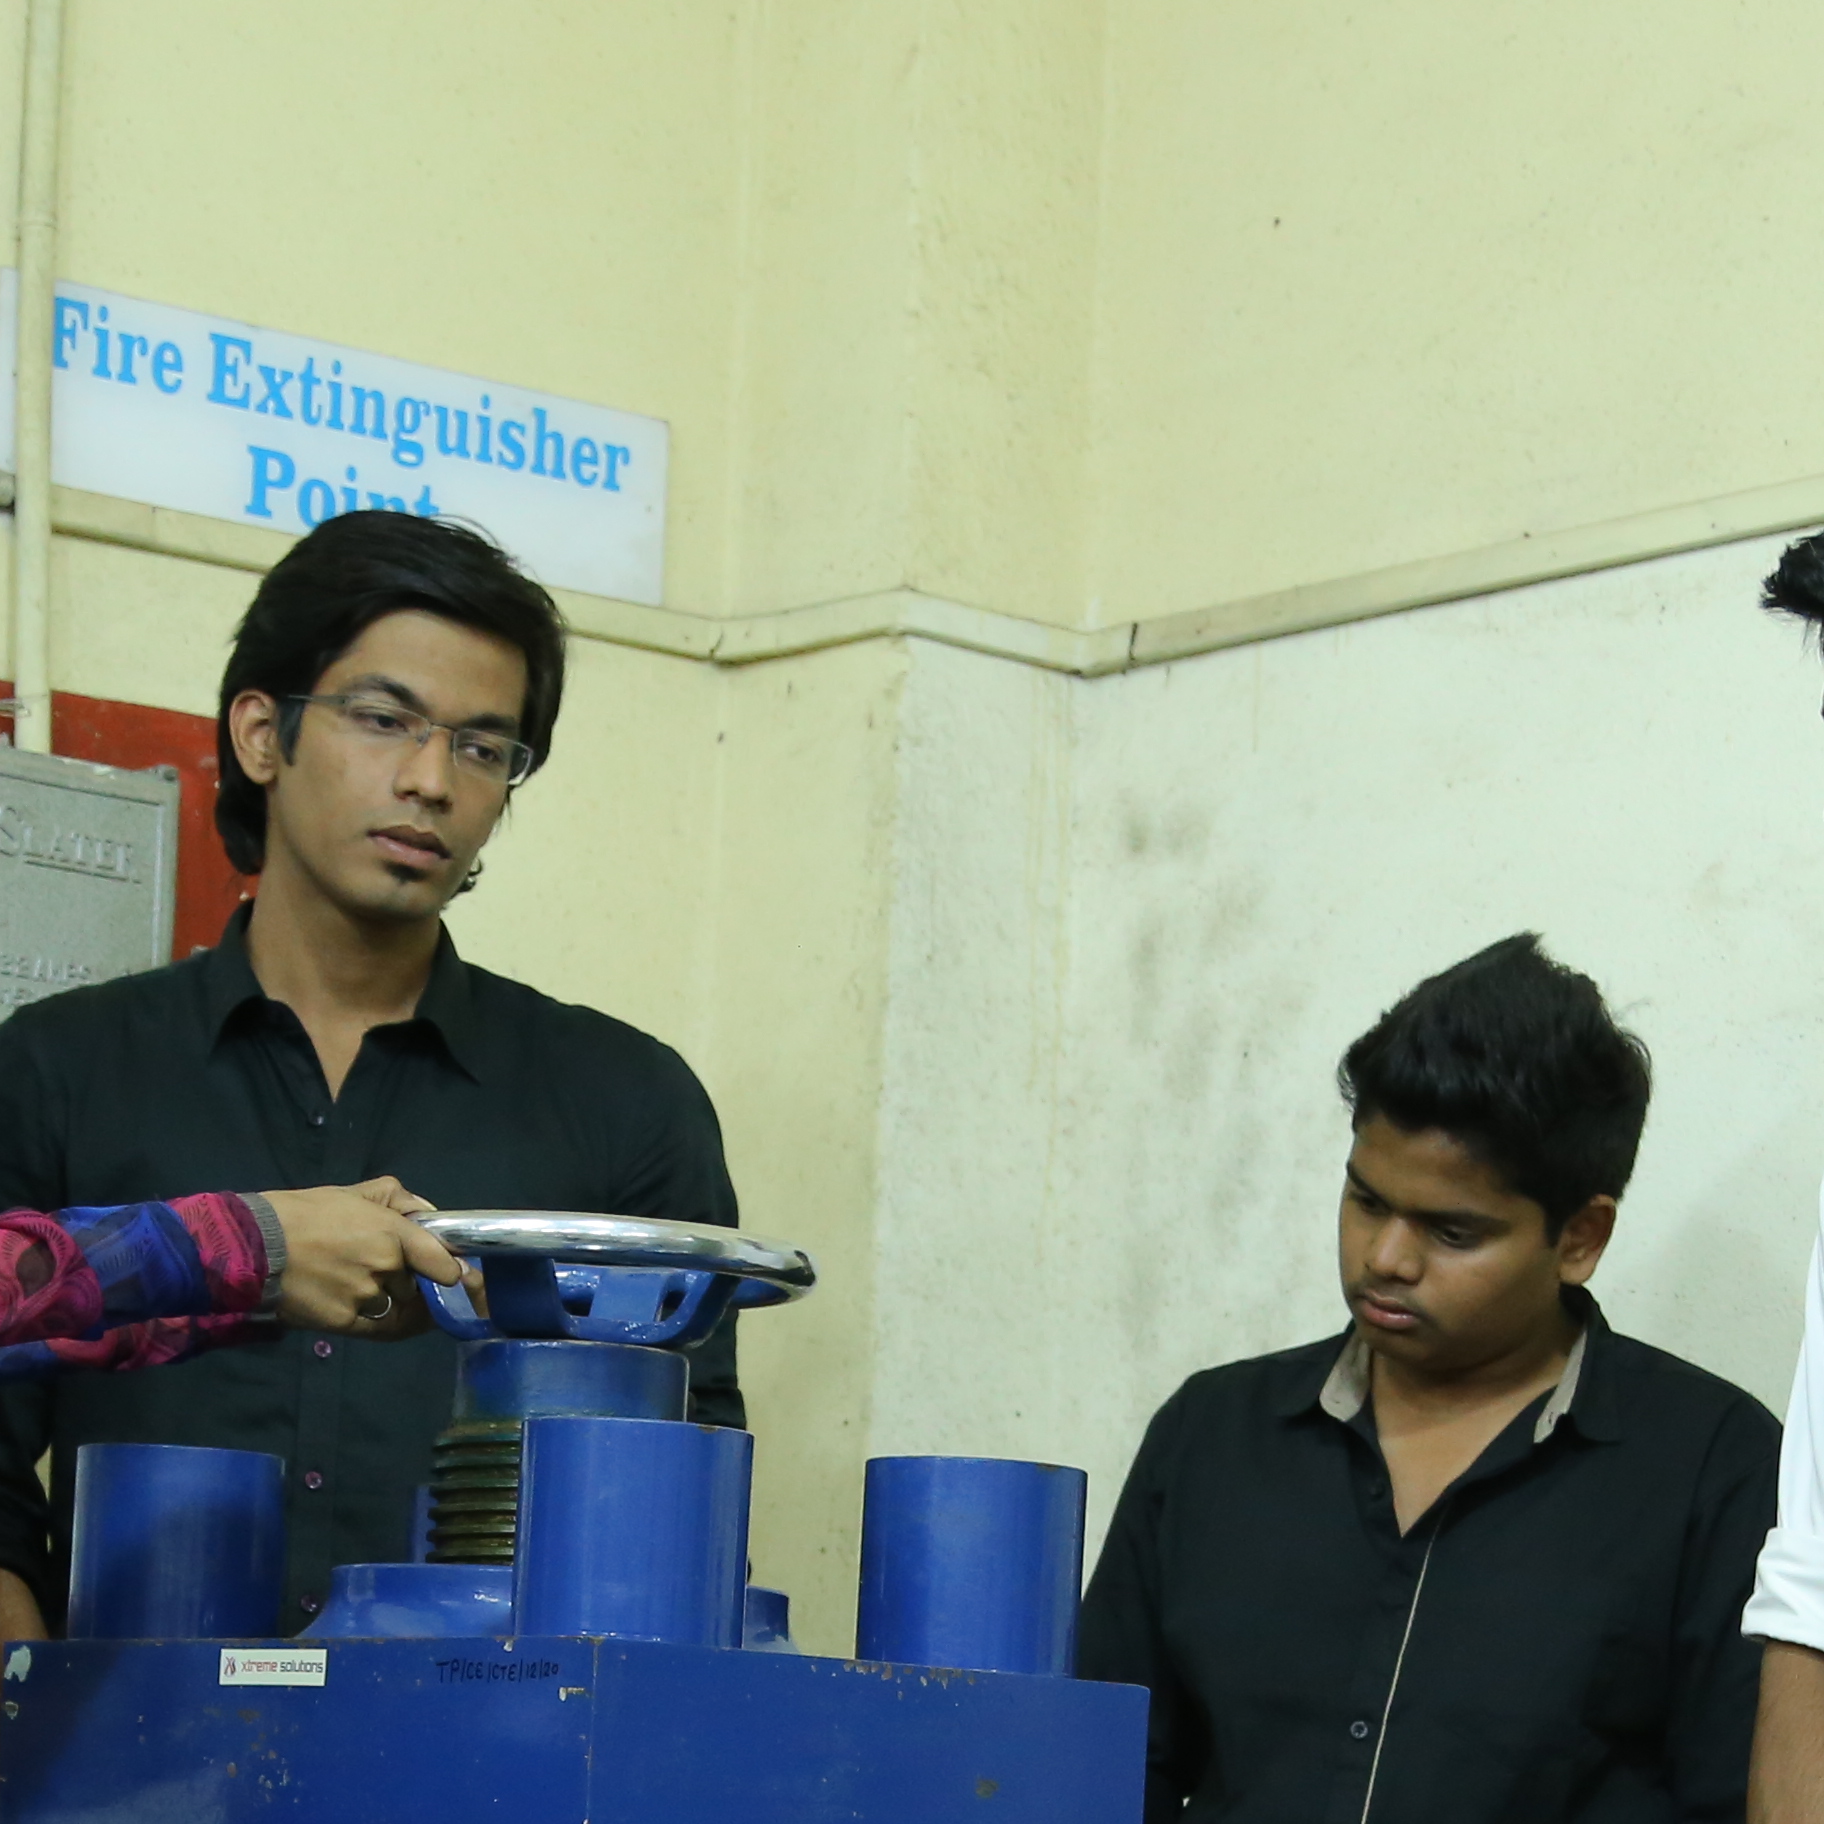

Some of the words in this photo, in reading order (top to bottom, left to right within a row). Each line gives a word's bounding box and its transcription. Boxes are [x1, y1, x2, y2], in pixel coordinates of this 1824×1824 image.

[52, 295, 184, 395] Fire
[207, 332, 630, 494] Extinguisher
[241, 1659, 276, 1674] xtreme
[279, 1659, 324, 1676] solutions
